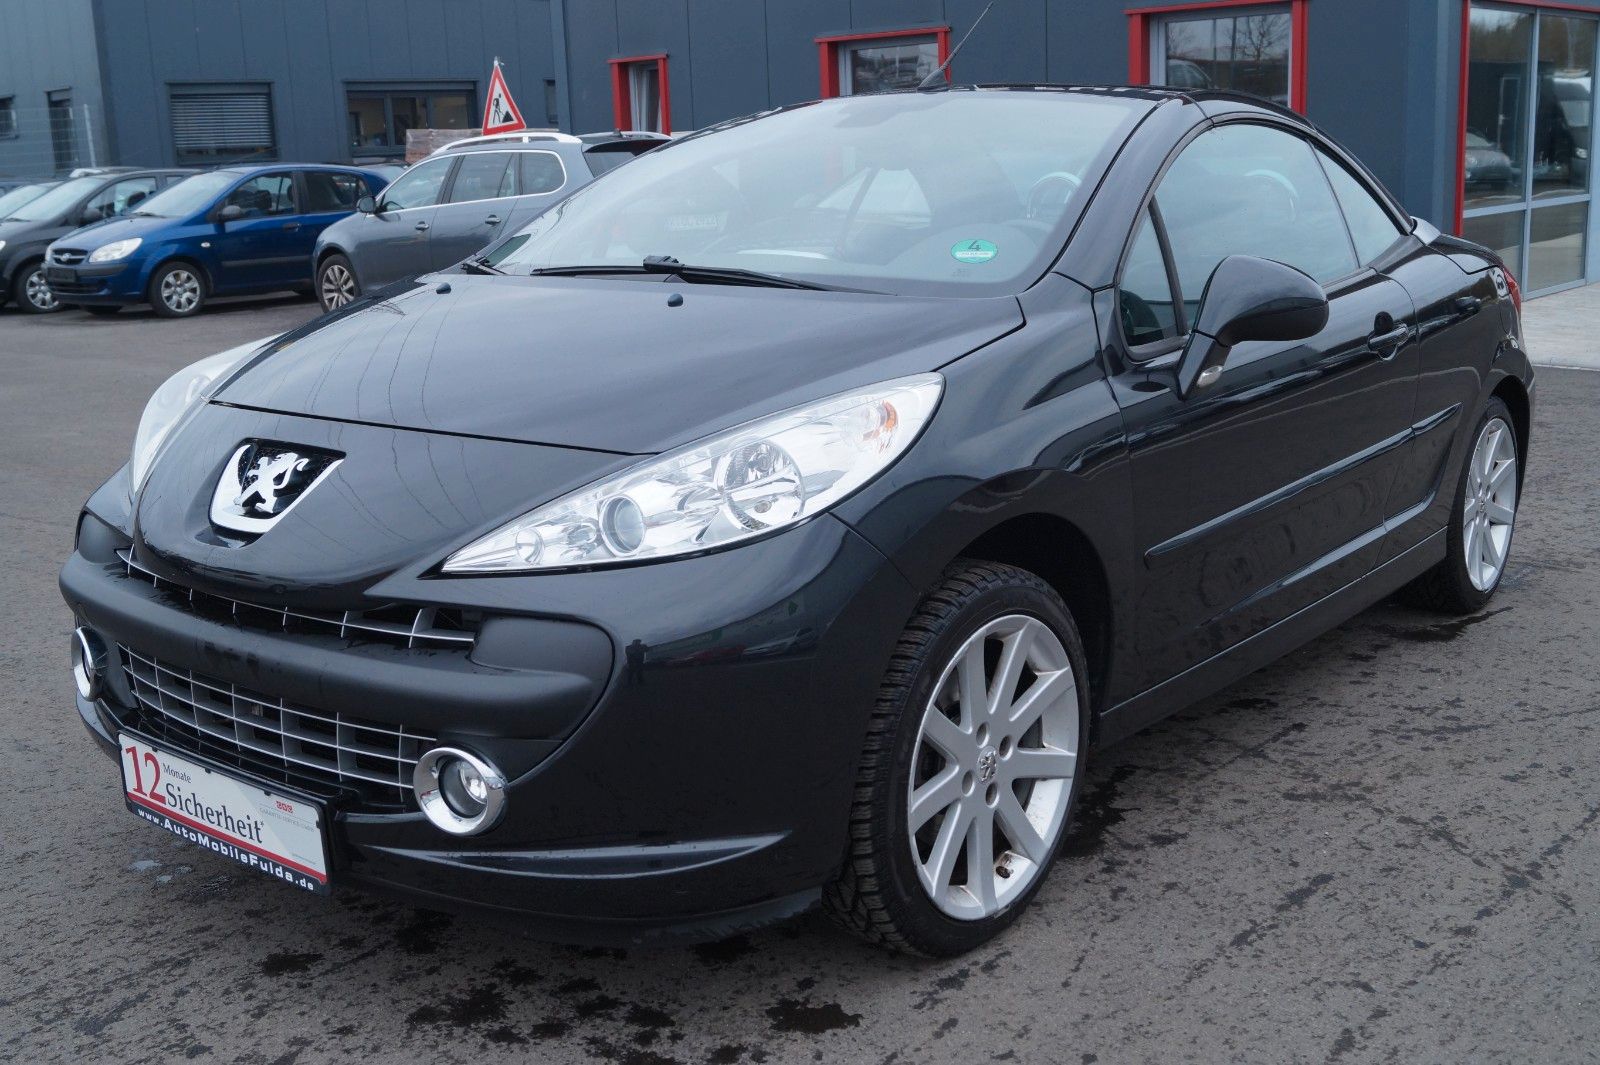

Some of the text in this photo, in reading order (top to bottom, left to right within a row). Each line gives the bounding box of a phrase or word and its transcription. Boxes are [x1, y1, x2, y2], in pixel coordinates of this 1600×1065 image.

[967, 240, 982, 251] 4
[125, 746, 191, 805] 12 Monate
[137, 808, 314, 891] www.AutoMobileFulda.de
